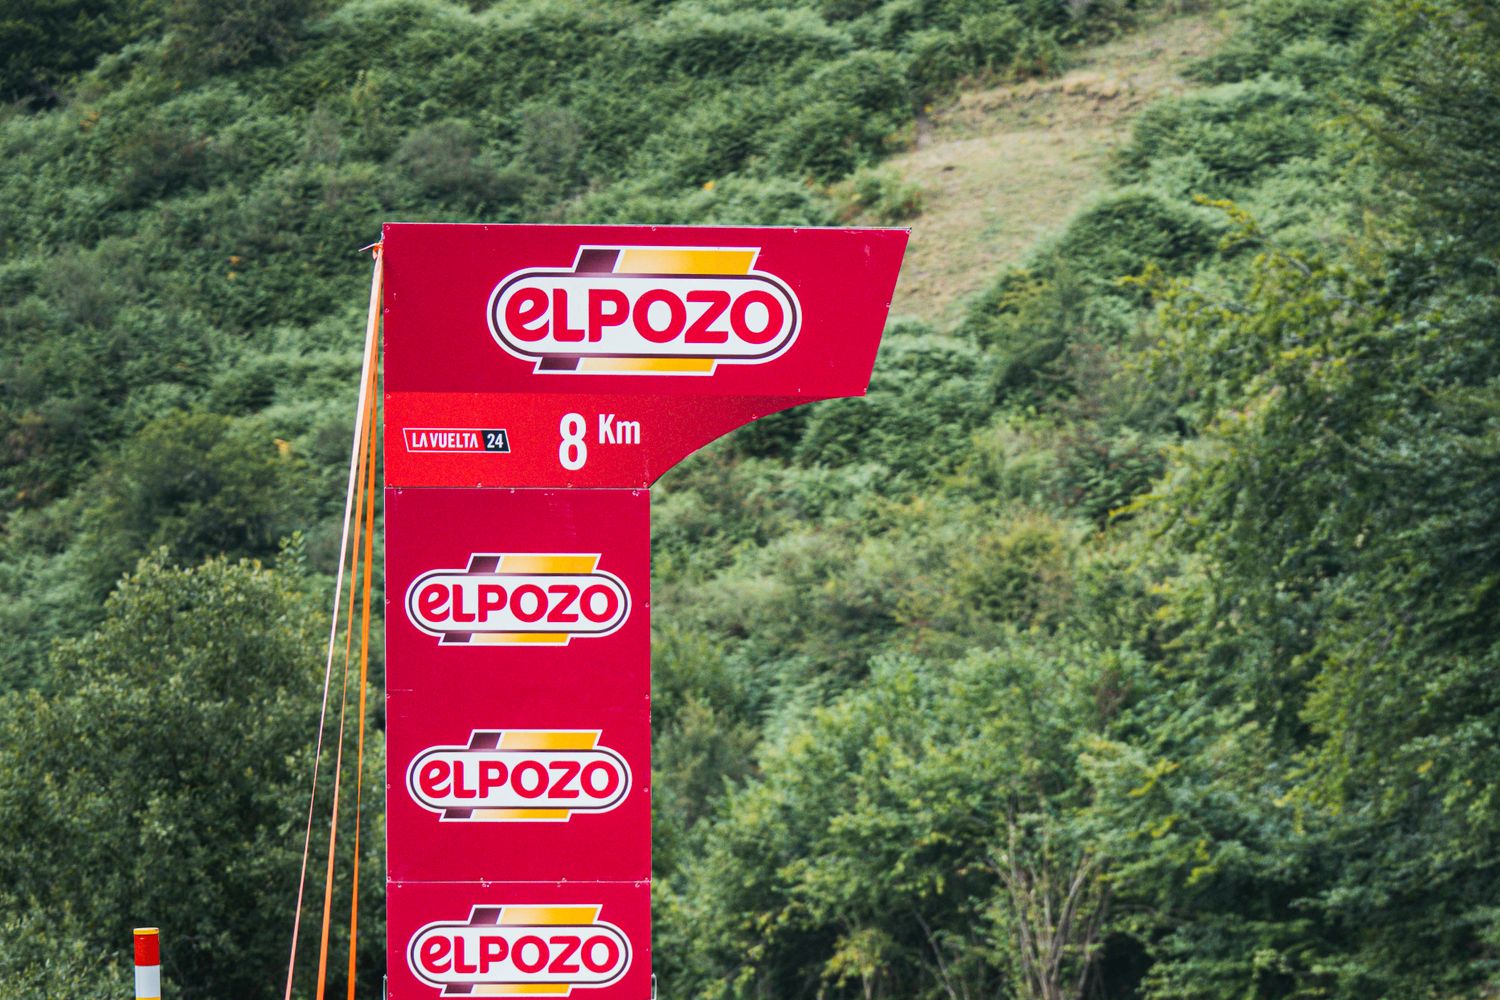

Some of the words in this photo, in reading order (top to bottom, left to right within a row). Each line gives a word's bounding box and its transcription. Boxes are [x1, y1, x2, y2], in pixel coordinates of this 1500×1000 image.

[412, 433, 428, 448] LA
[430, 433, 478, 448] VUELTA
[486, 434, 504, 448] 24
[559, 412, 587, 471] 8
[598, 413, 641, 445] Km
